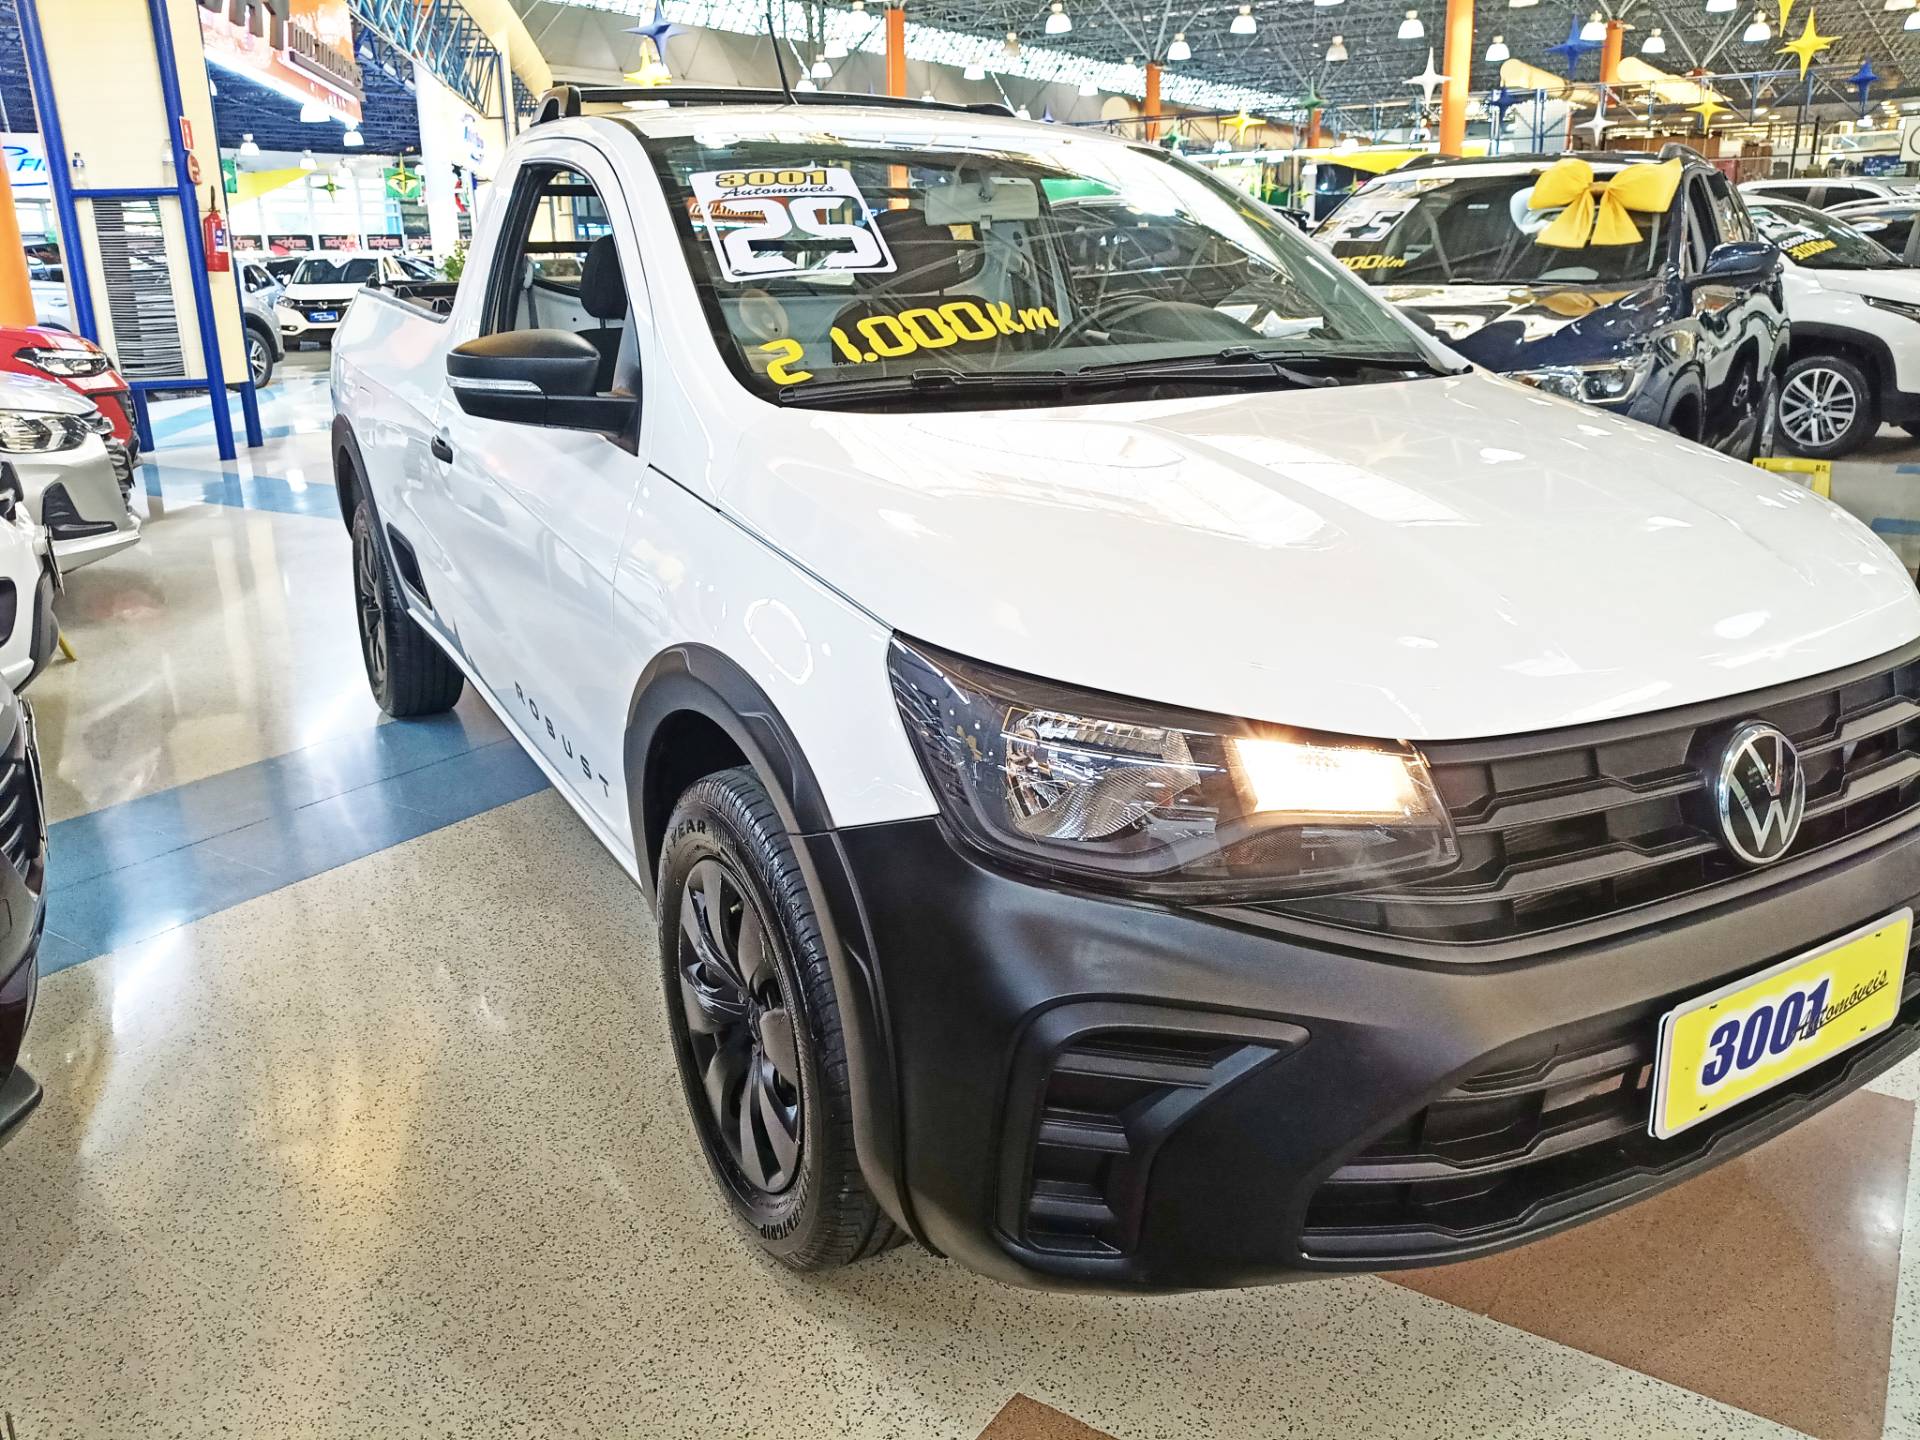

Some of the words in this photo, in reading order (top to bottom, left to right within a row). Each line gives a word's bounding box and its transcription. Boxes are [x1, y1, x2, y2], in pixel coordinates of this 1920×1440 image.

[715, 169, 828, 189] 3001
[722, 184, 837, 199] Automóveis
[721, 196, 885, 274] 25
[514, 680, 610, 798] ROBUST
[1701, 978, 1830, 1087] 3001
[1795, 968, 1889, 1041] Automóveis
